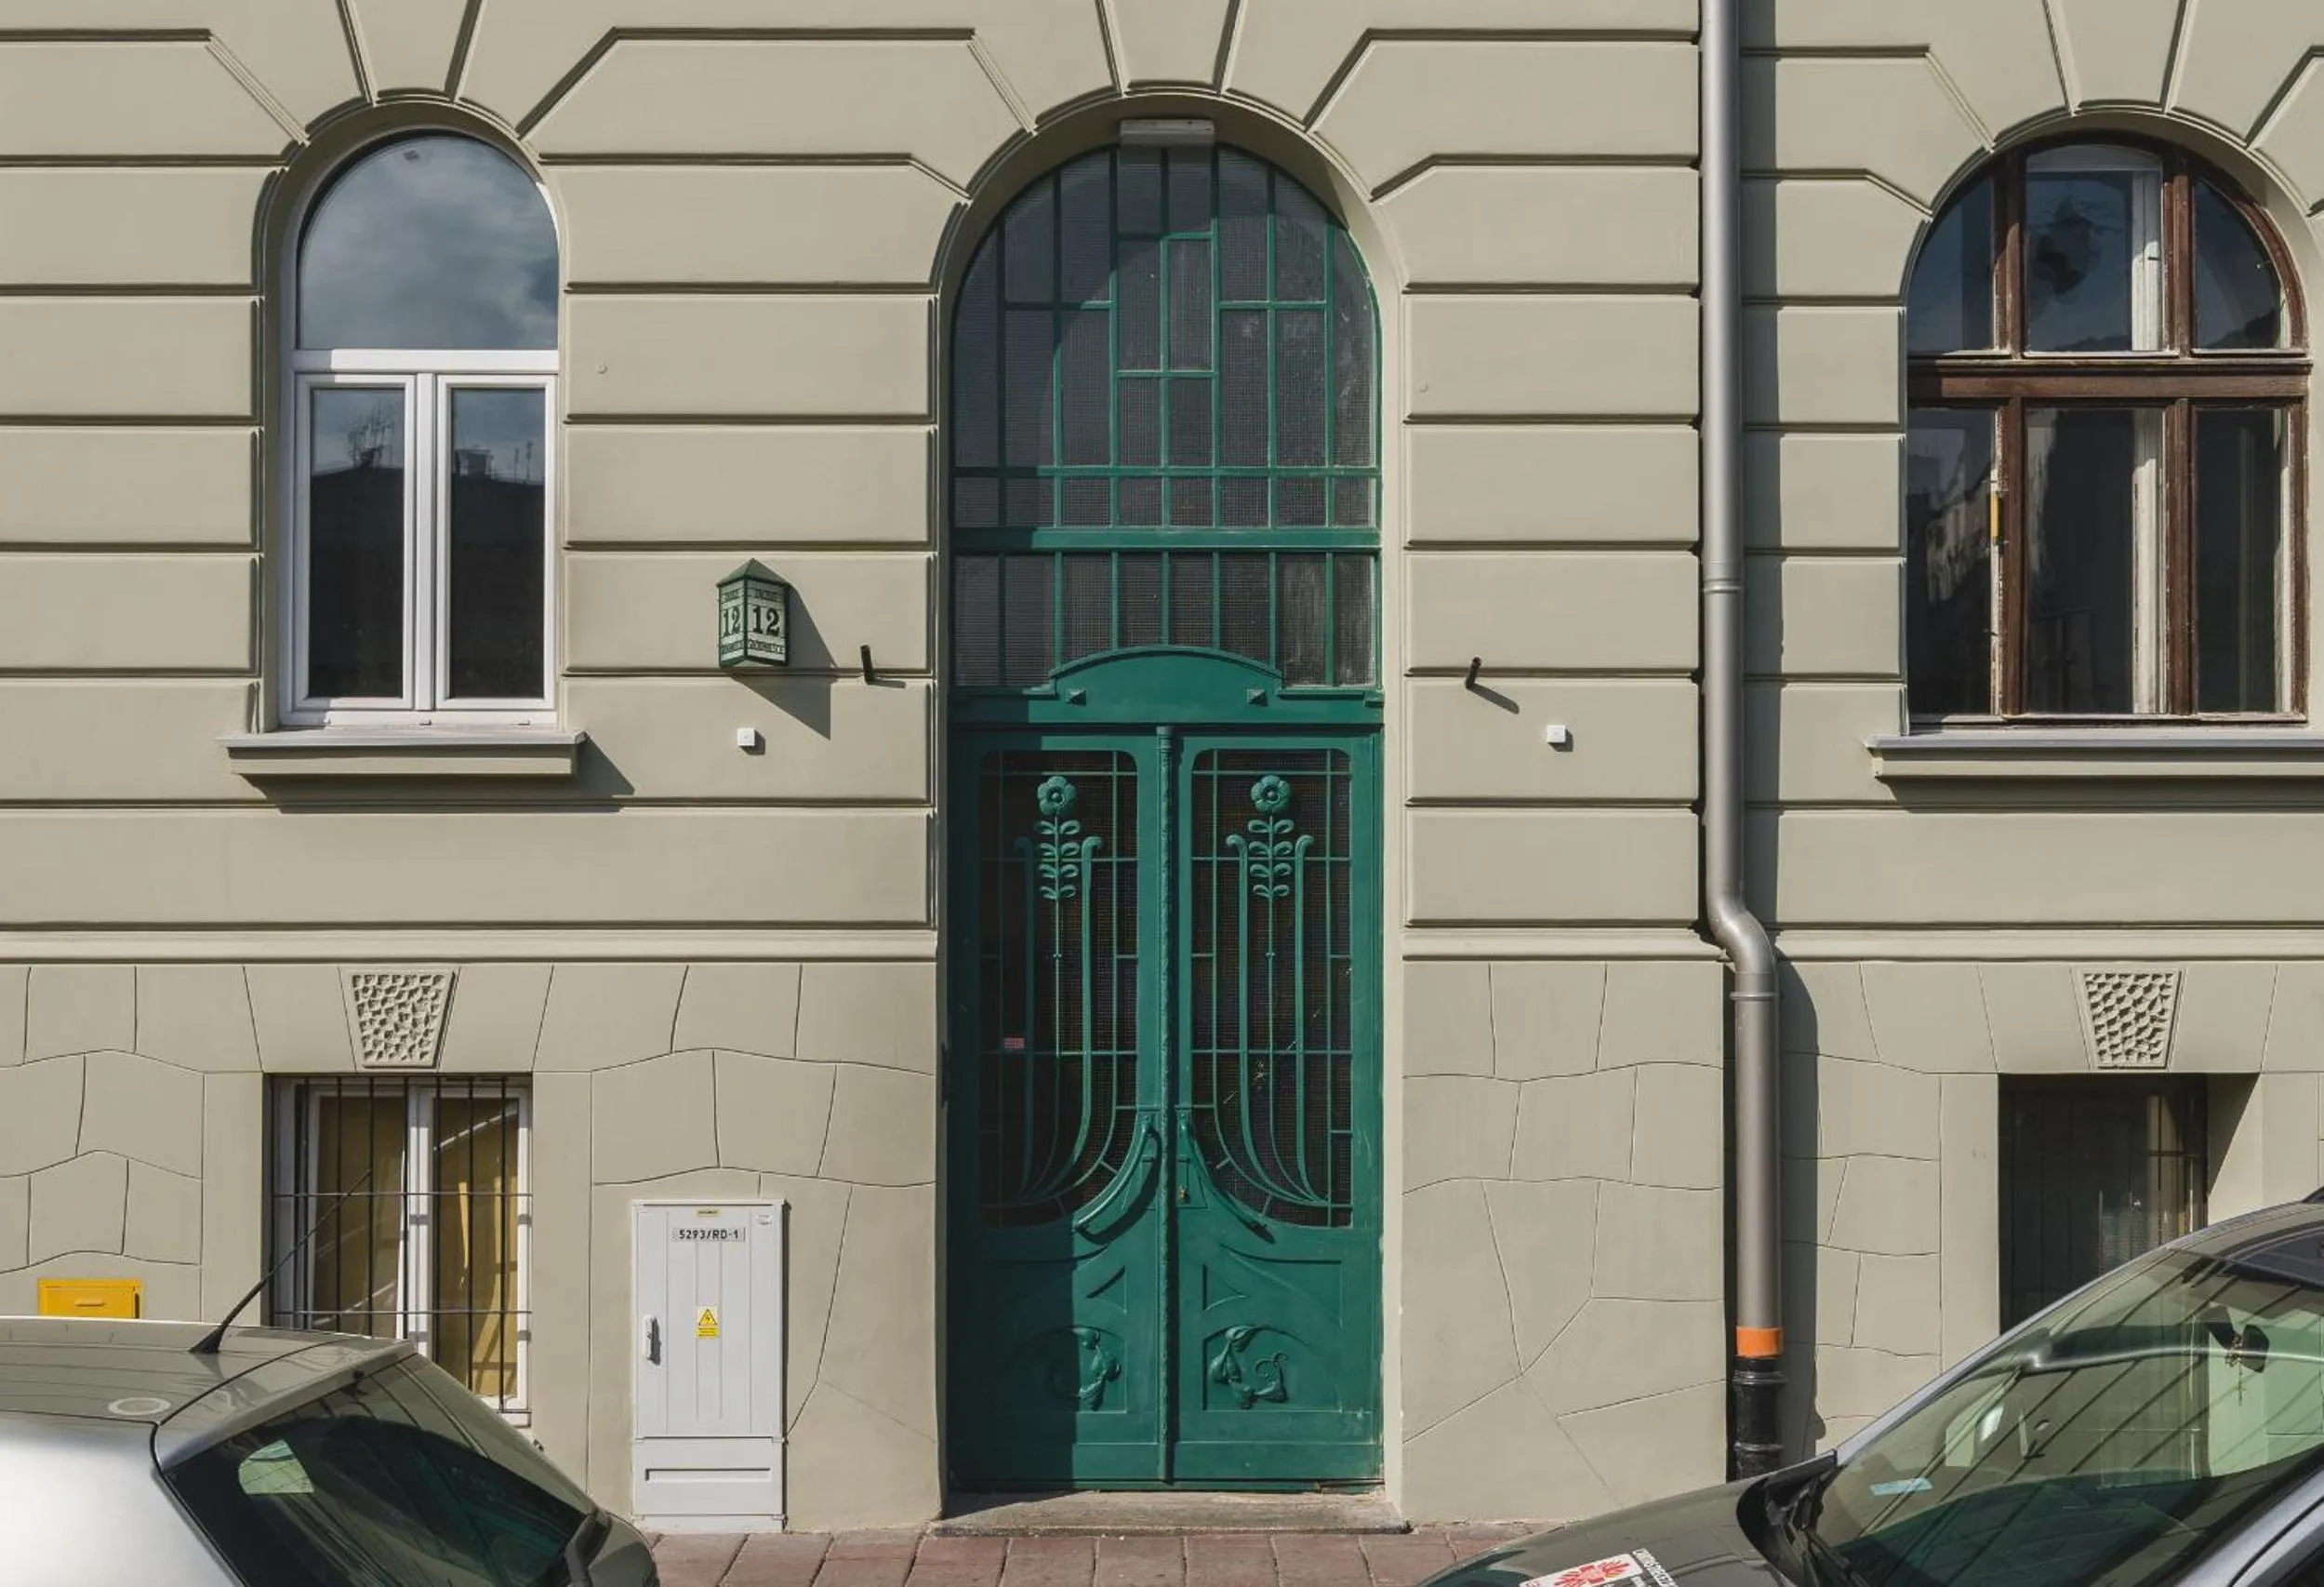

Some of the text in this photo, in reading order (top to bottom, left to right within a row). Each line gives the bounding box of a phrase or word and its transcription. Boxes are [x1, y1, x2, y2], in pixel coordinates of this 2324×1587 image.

[723, 606, 741, 637] 12
[752, 605, 780, 636] 12
[678, 1229, 738, 1240] 5293/RD-1
